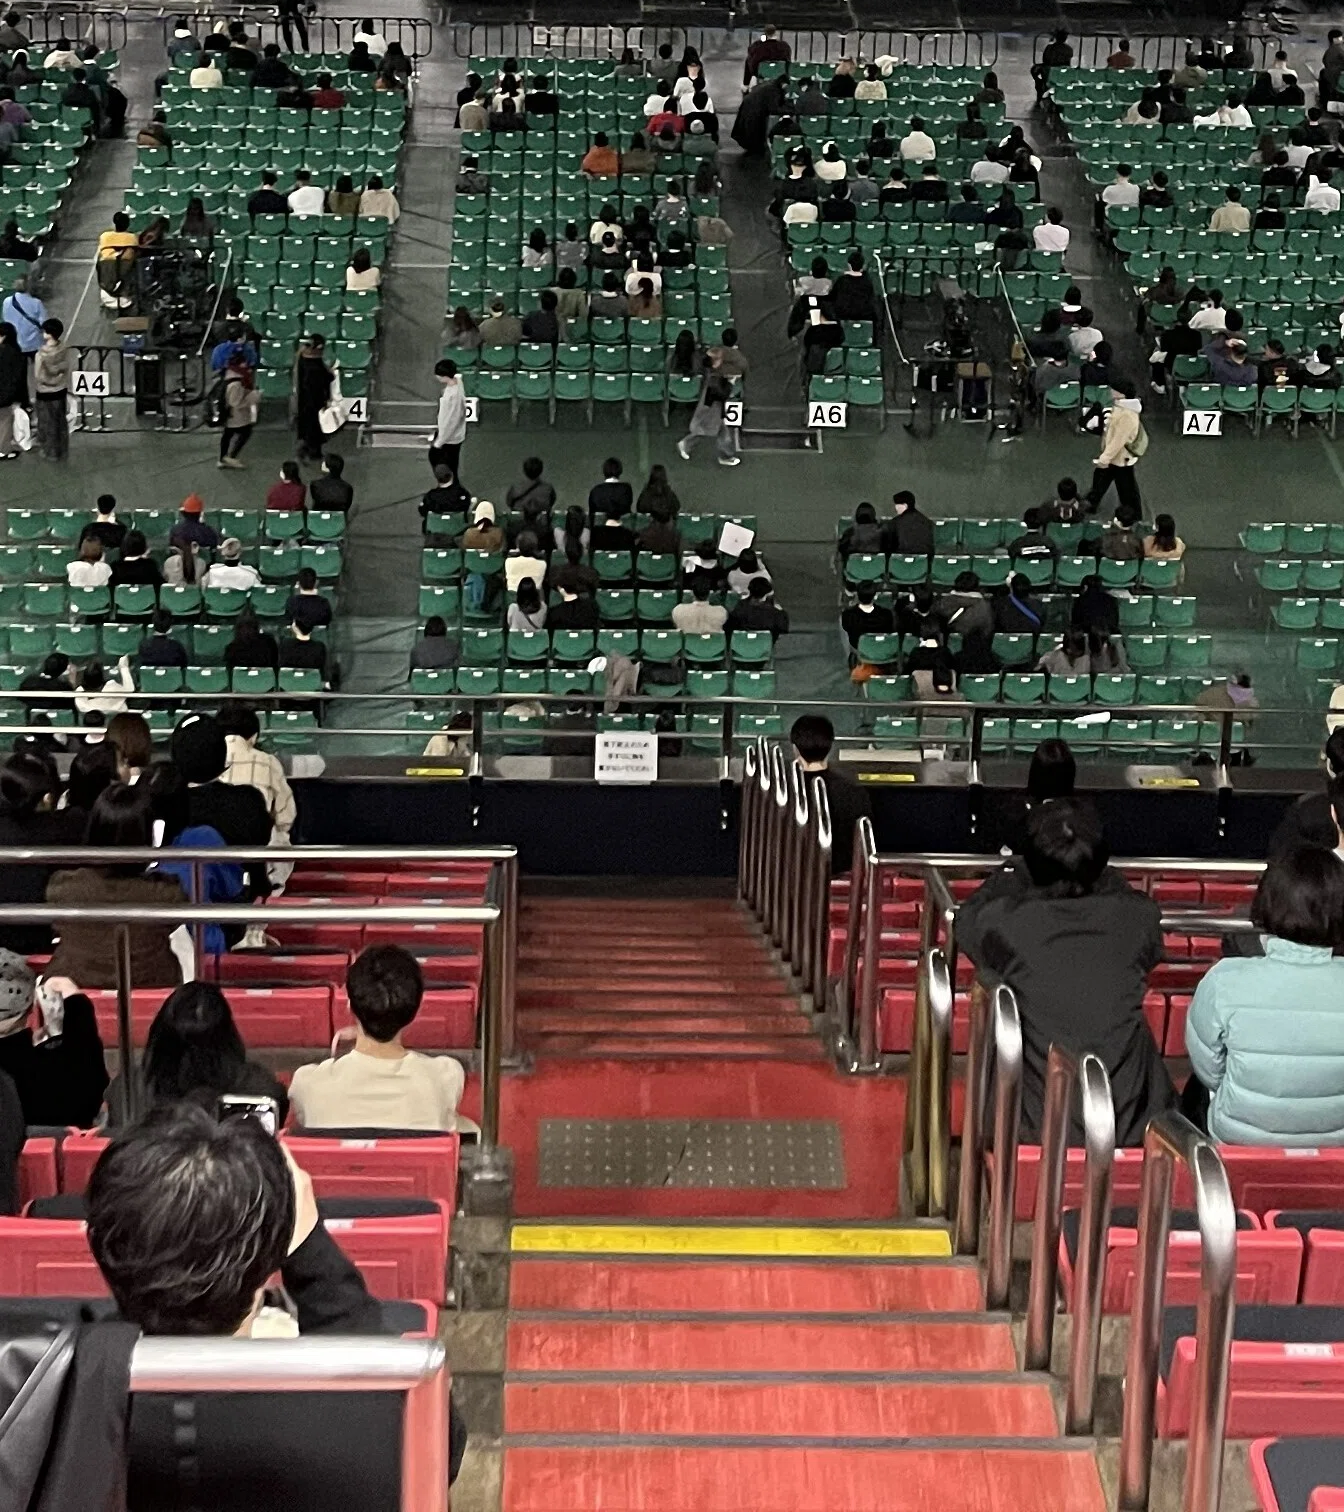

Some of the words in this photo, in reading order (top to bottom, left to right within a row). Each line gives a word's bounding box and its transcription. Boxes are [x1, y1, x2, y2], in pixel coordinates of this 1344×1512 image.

[76, 374, 106, 393] A4
[812, 405, 842, 424] A6
[1186, 413, 1217, 432] A7
